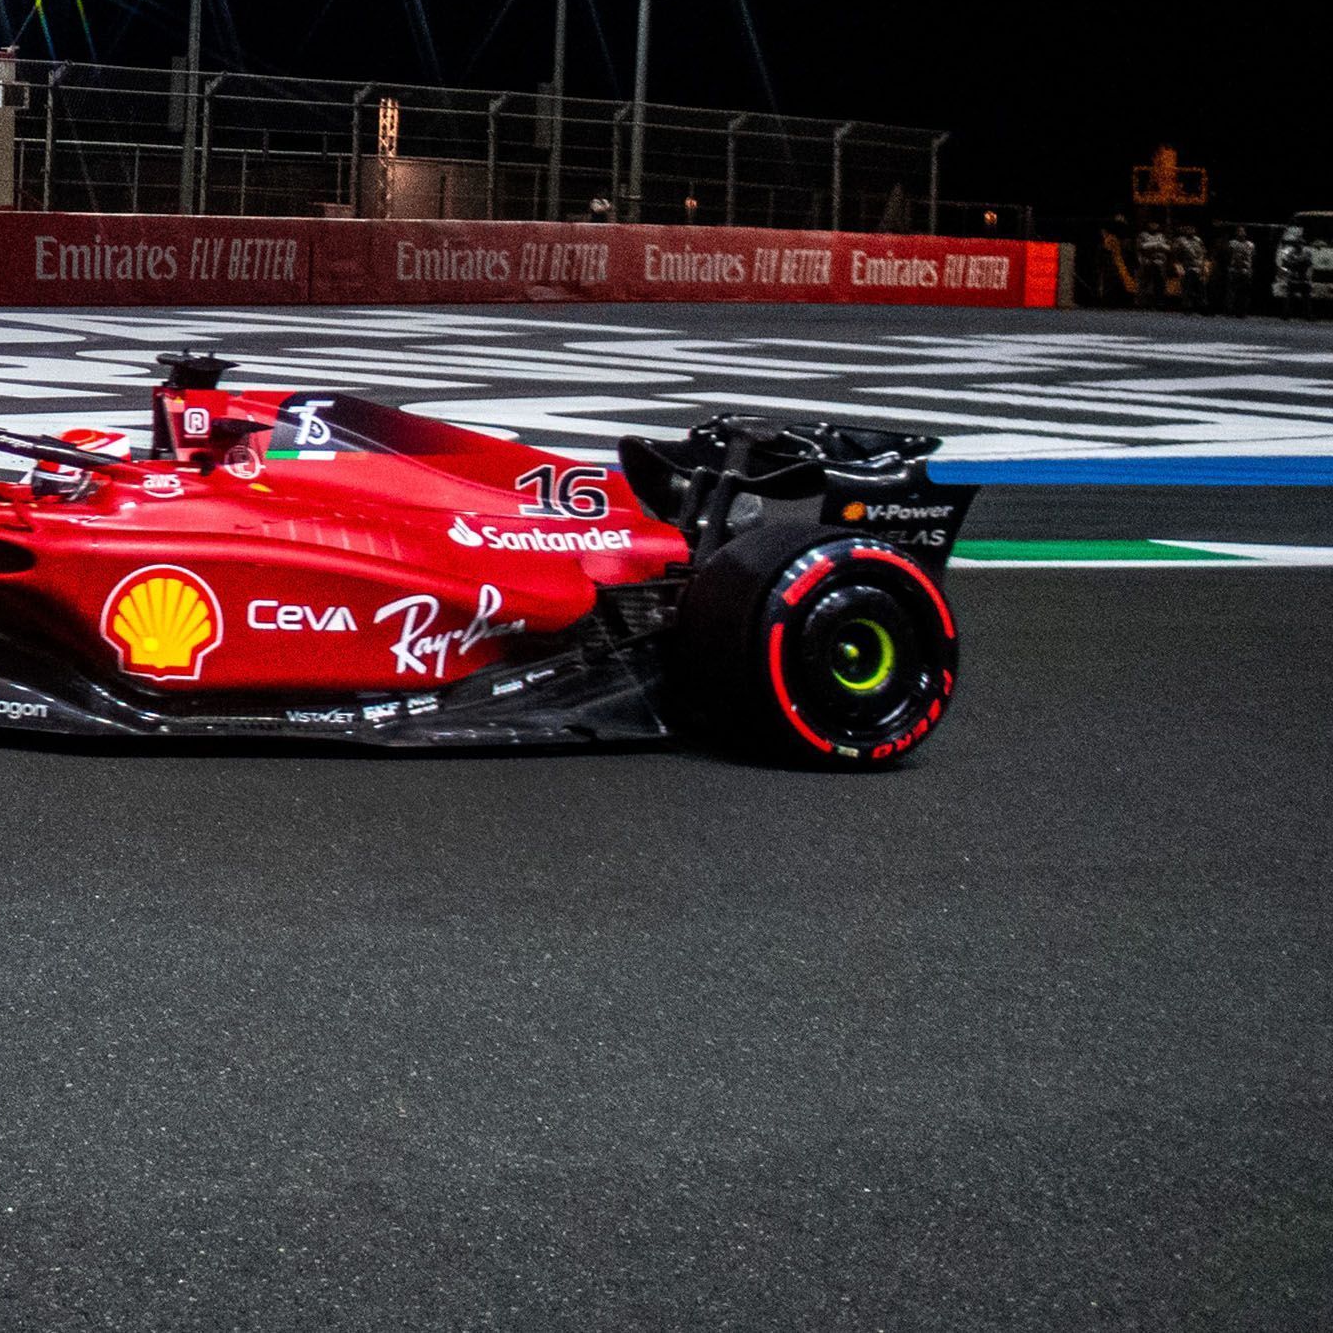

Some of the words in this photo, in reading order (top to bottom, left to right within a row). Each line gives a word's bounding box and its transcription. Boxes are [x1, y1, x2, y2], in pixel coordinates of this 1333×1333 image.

[35, 235, 177, 281] Emirates
[189, 237, 225, 280] FLY
[228, 238, 298, 282] BETTER
[396, 239, 510, 282] Emirates
[644, 243, 745, 283] Emirates
[850, 250, 939, 287] Emirates
[515, 463, 610, 520] 16
[865, 504, 953, 521] V-Power
[481, 525, 633, 552] Santander
